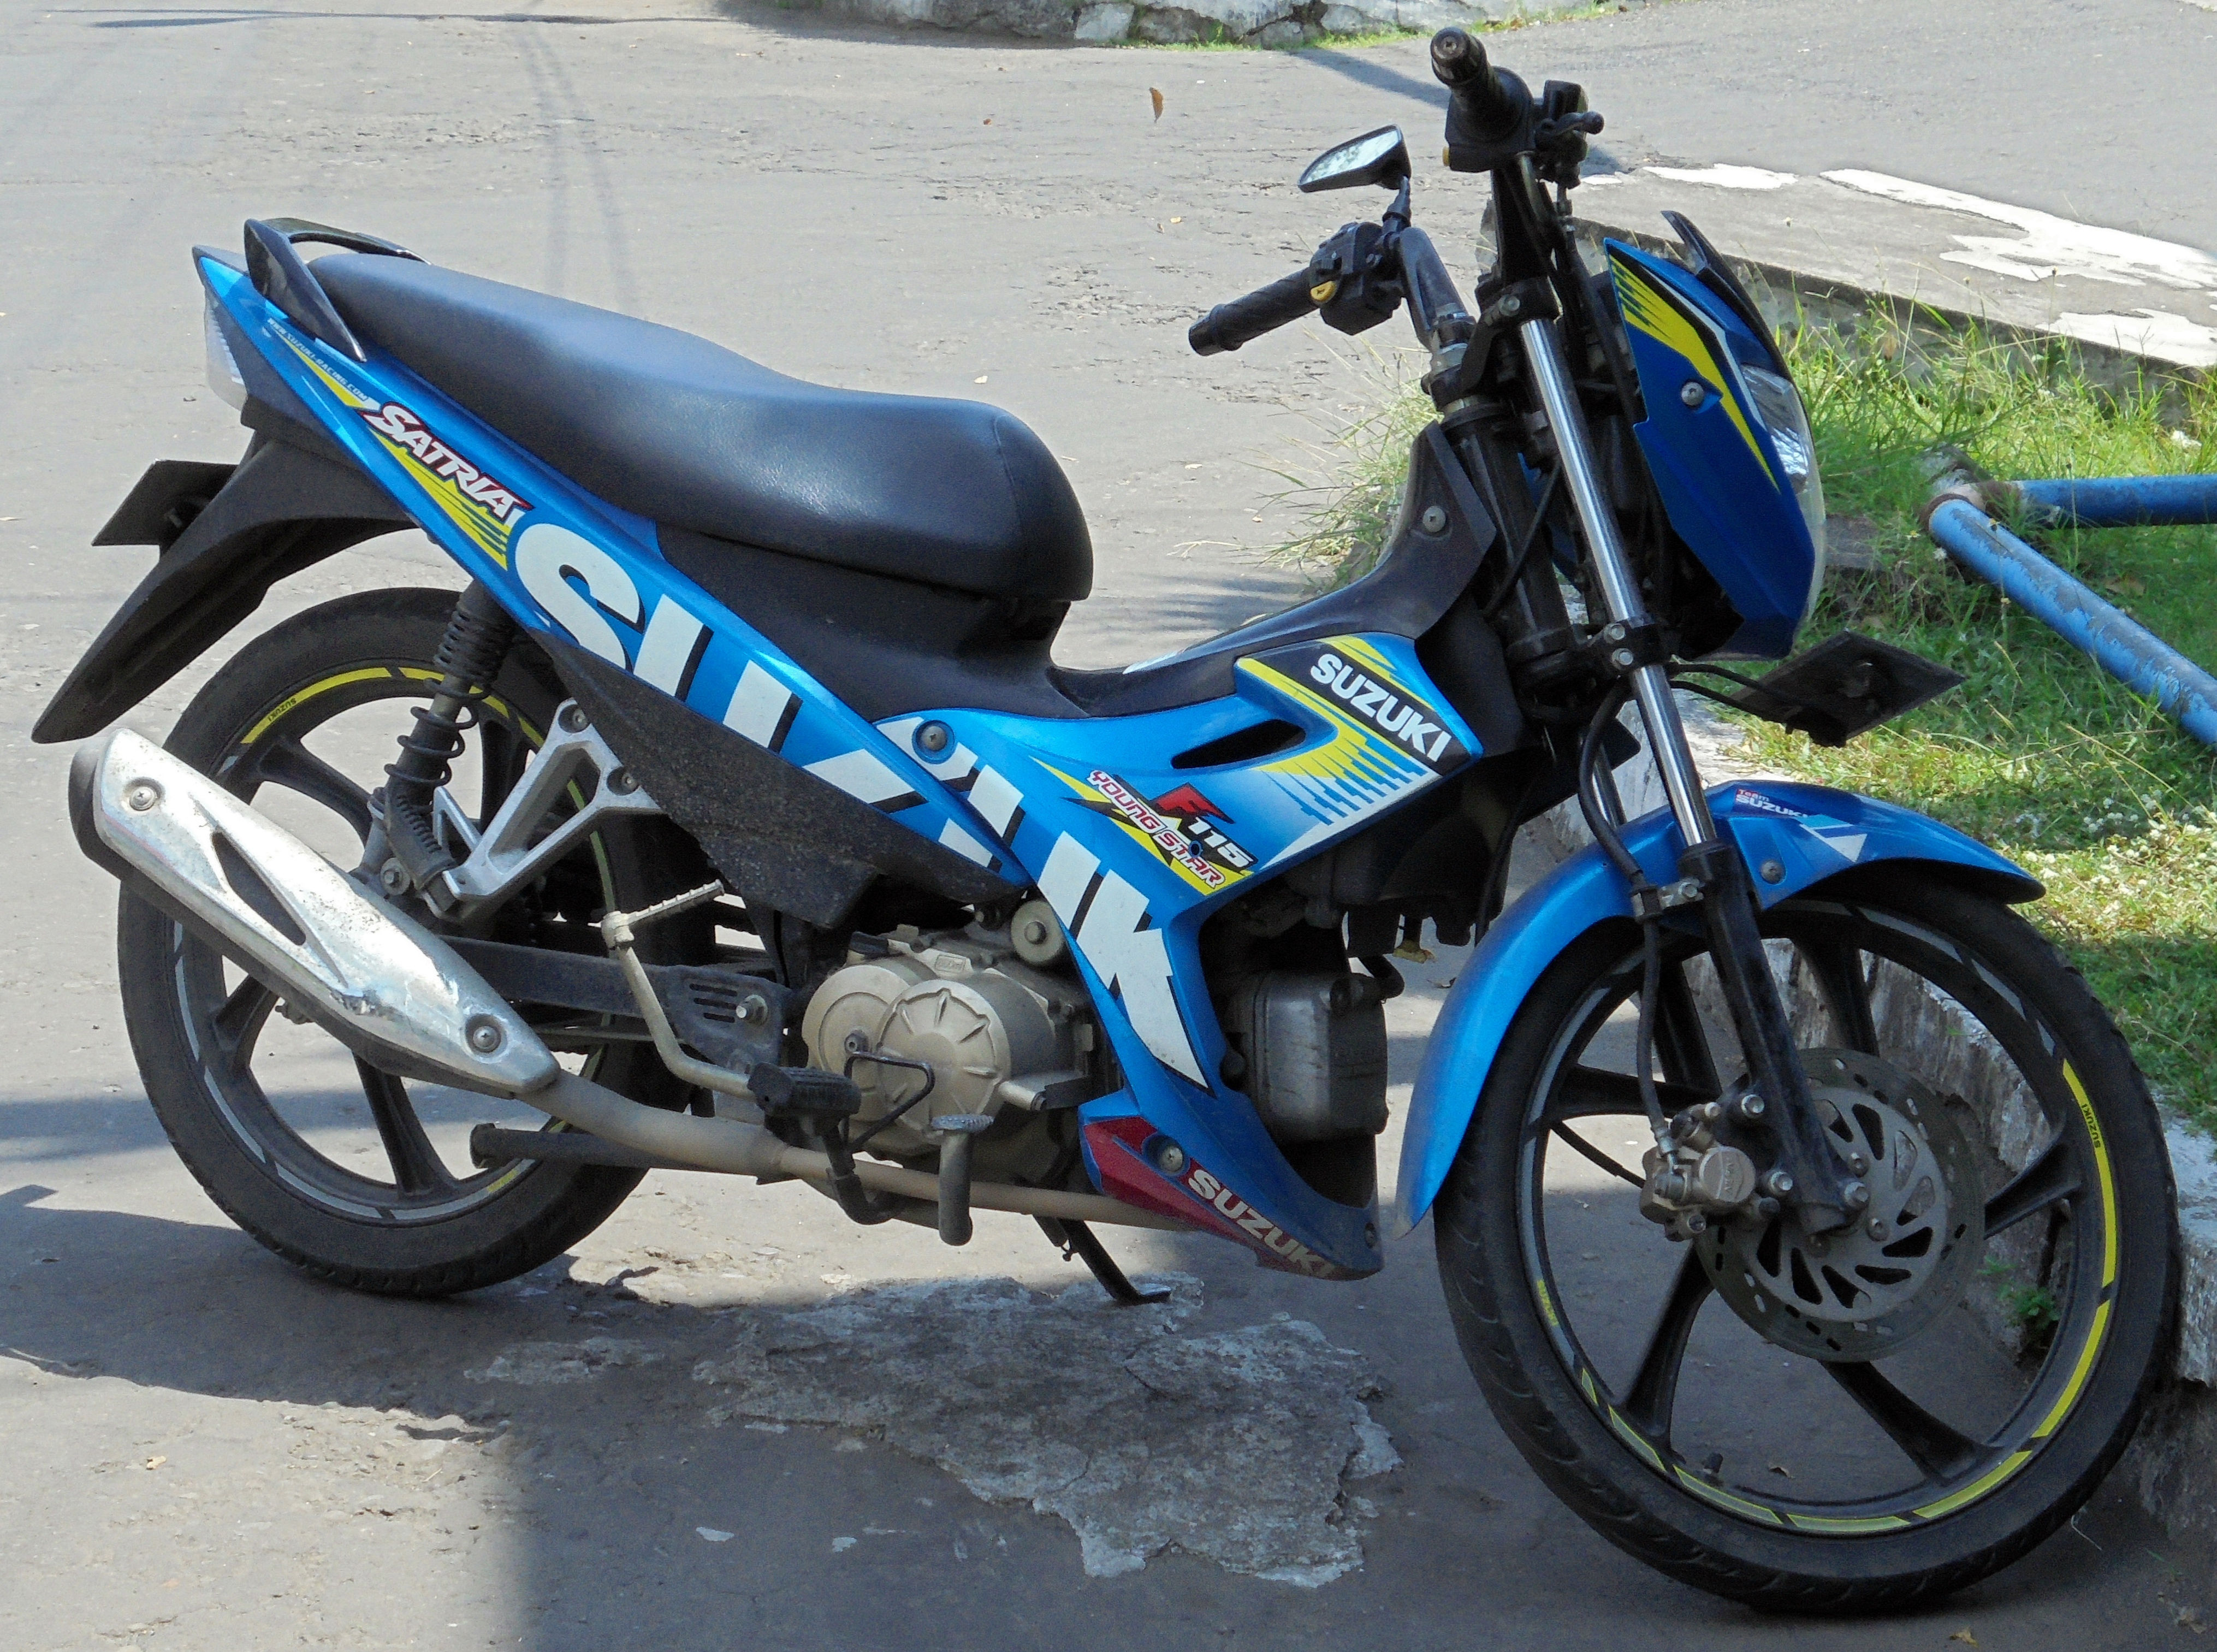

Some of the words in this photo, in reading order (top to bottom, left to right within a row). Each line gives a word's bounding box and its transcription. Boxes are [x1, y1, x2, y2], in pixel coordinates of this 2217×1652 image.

[358, 402, 530, 519] SATRIA
[1311, 653, 1453, 762] SUZUKI
[1089, 770, 1164, 832] YOUNG
[1154, 831, 1224, 887] STAR
[1735, 794, 1809, 819] SUZUKI
[1738, 789, 1770, 802] Team
[1188, 817, 1254, 867] 115
[2081, 1104, 2101, 1148] SUZUKI
[1188, 1169, 1336, 1276] SUZUKI
